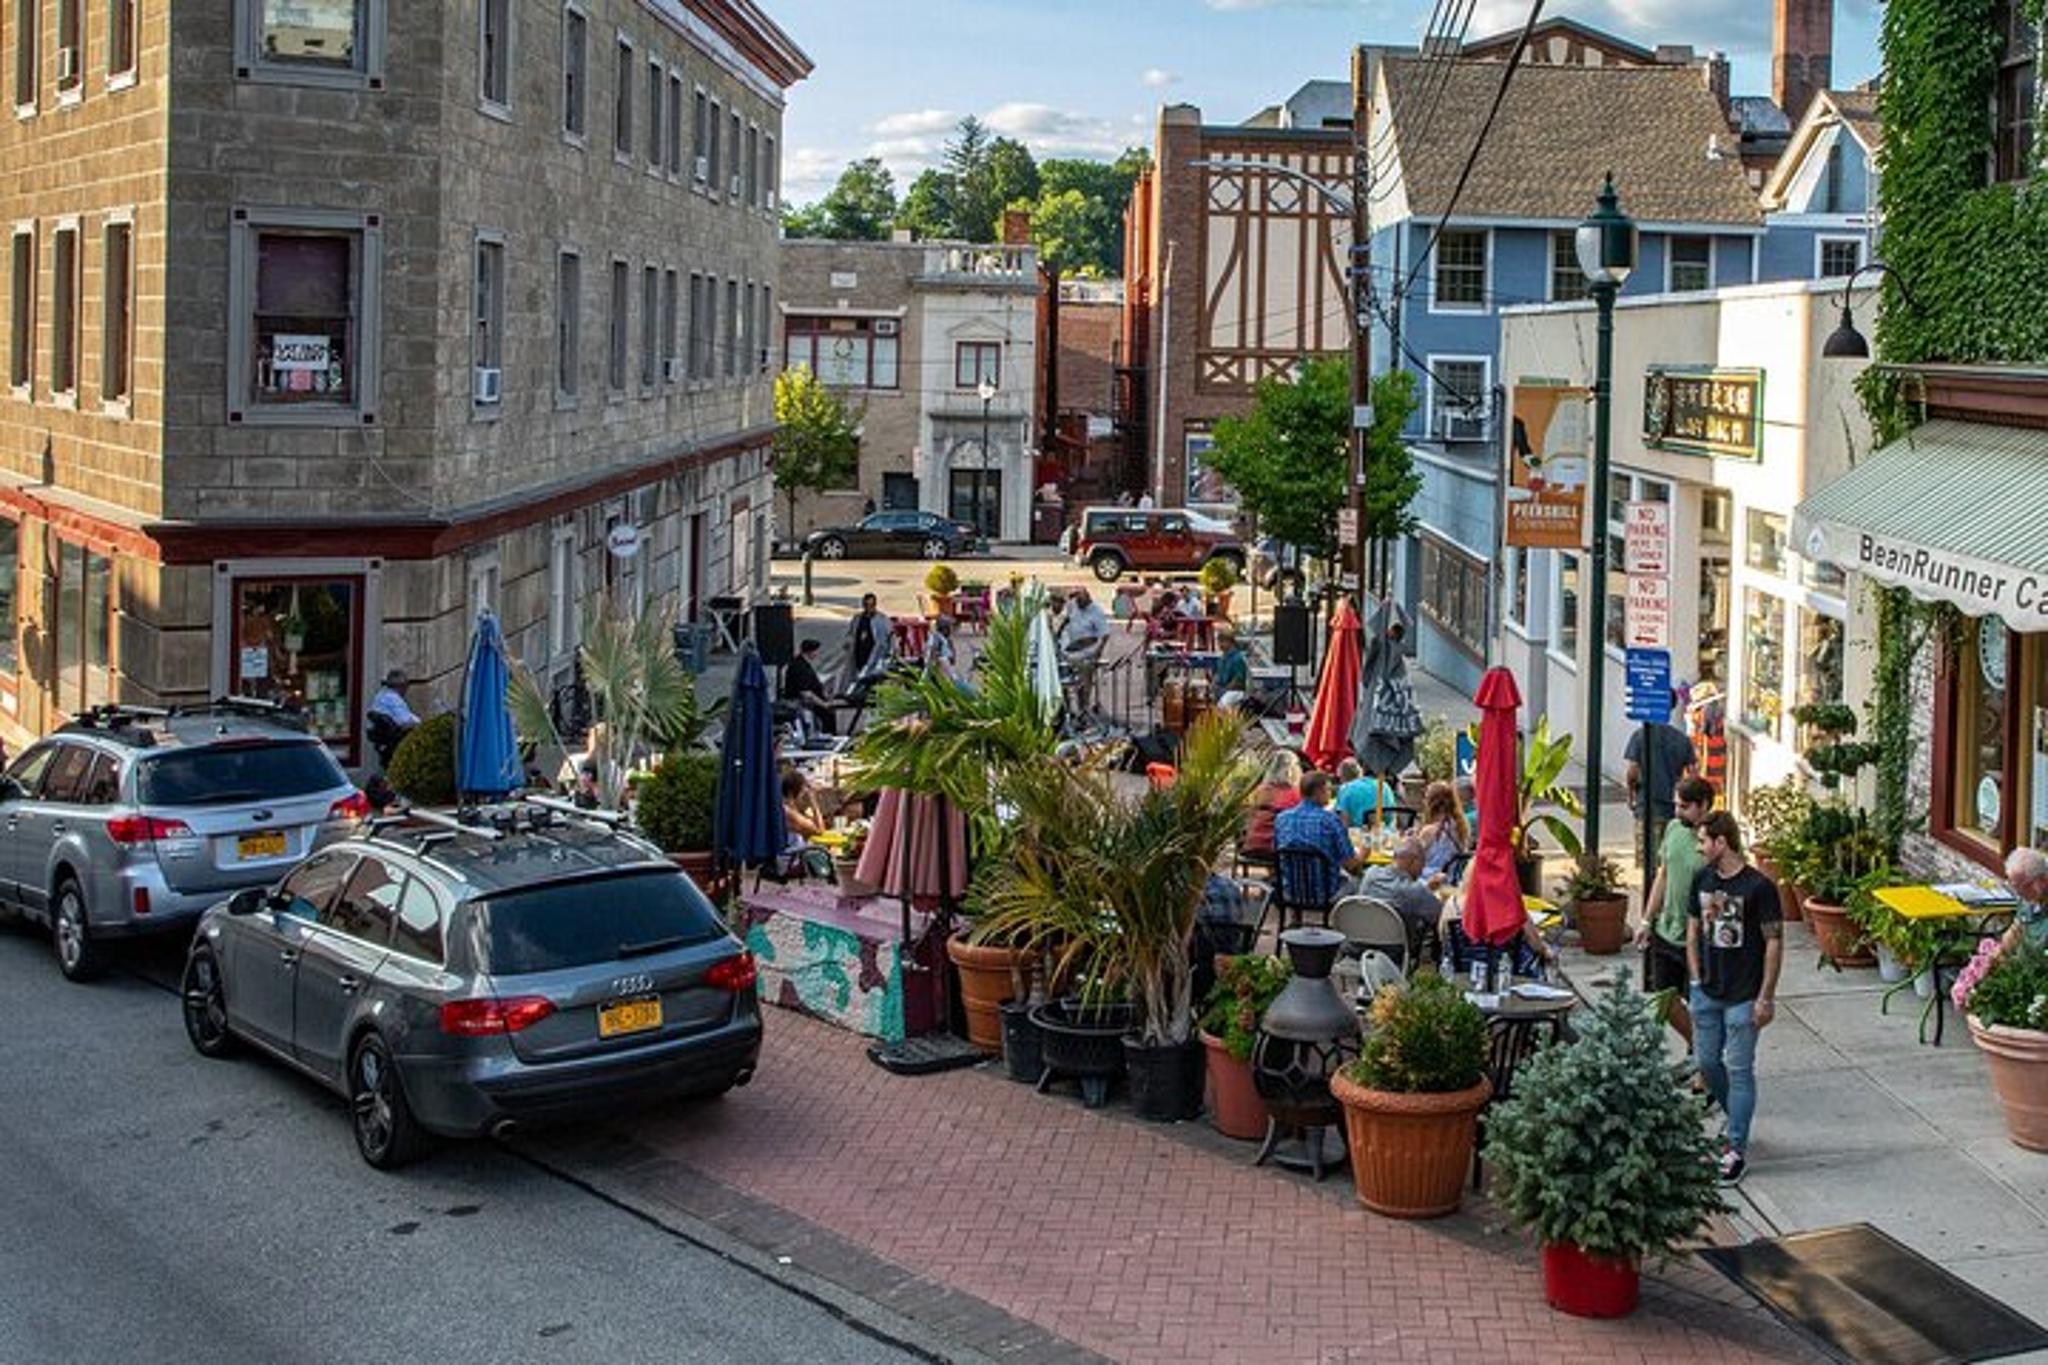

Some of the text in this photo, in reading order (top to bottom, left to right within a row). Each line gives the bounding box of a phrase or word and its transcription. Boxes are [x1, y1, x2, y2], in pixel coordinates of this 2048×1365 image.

[1513, 503, 1577, 518] PEEKSKILL
[1637, 508, 1656, 521] NO
[1627, 523, 1667, 538] PARKING
[1859, 534, 2006, 601] BeanRunner
[1638, 579, 1656, 595] NO
[1628, 596, 1667, 611] PARKING
